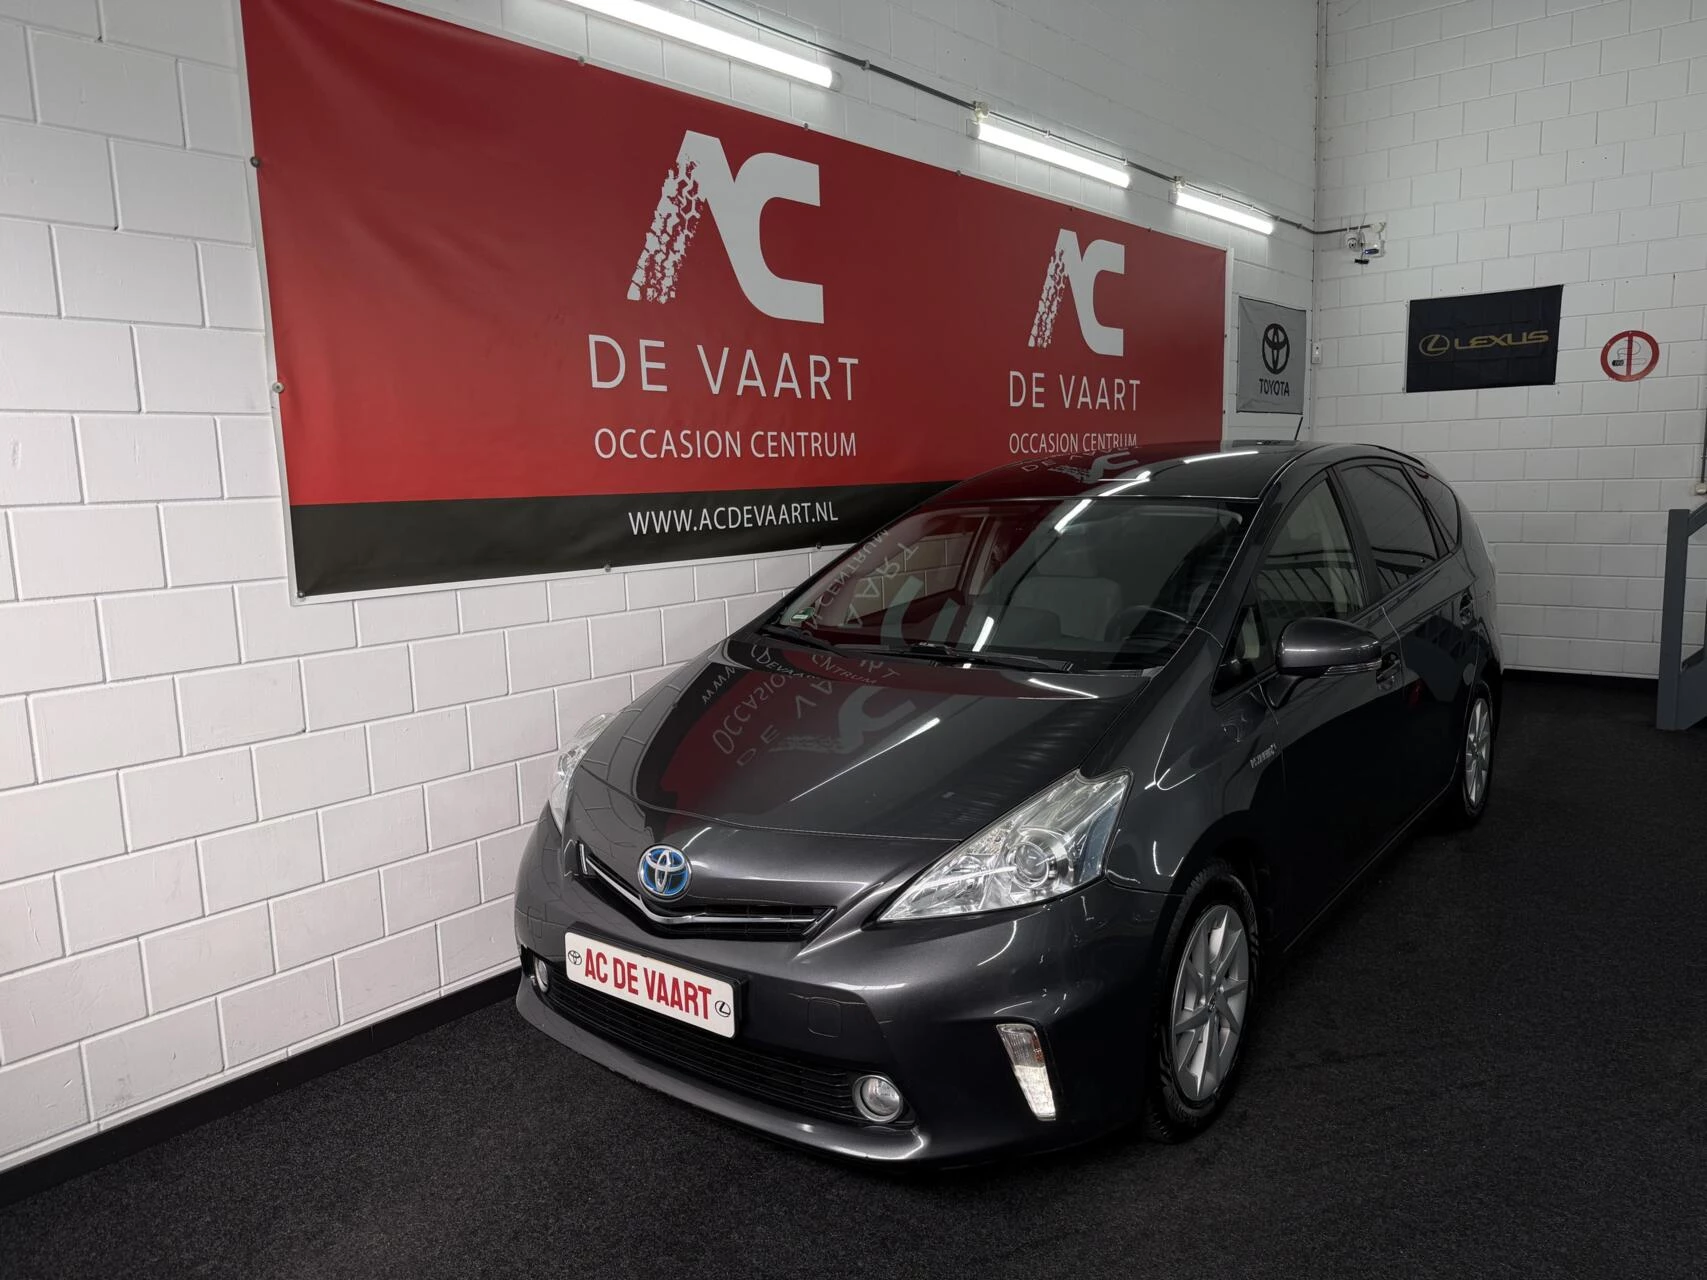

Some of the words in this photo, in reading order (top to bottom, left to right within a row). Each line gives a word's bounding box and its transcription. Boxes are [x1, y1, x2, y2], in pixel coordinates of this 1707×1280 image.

[627, 130, 824, 324] AC
[1028, 228, 1125, 357] AC
[1454, 330, 1549, 350] LEXUS
[588, 334, 668, 393] DE
[697, 344, 859, 401] VAART
[1009, 370, 1045, 408] DE
[1059, 374, 1141, 412] VAART
[1259, 378, 1290, 397] TOYOTA
[594, 427, 742, 459] OCCASION
[751, 430, 857, 458] CENTRUM
[1009, 432, 1079, 454] OCCASION
[1082, 433, 1137, 453] CENTRUM
[628, 501, 839, 536] WWW.ACDEVAART.NL
[585, 948, 608, 984] AC
[613, 957, 639, 996] DE
[643, 967, 712, 1020] VAART
